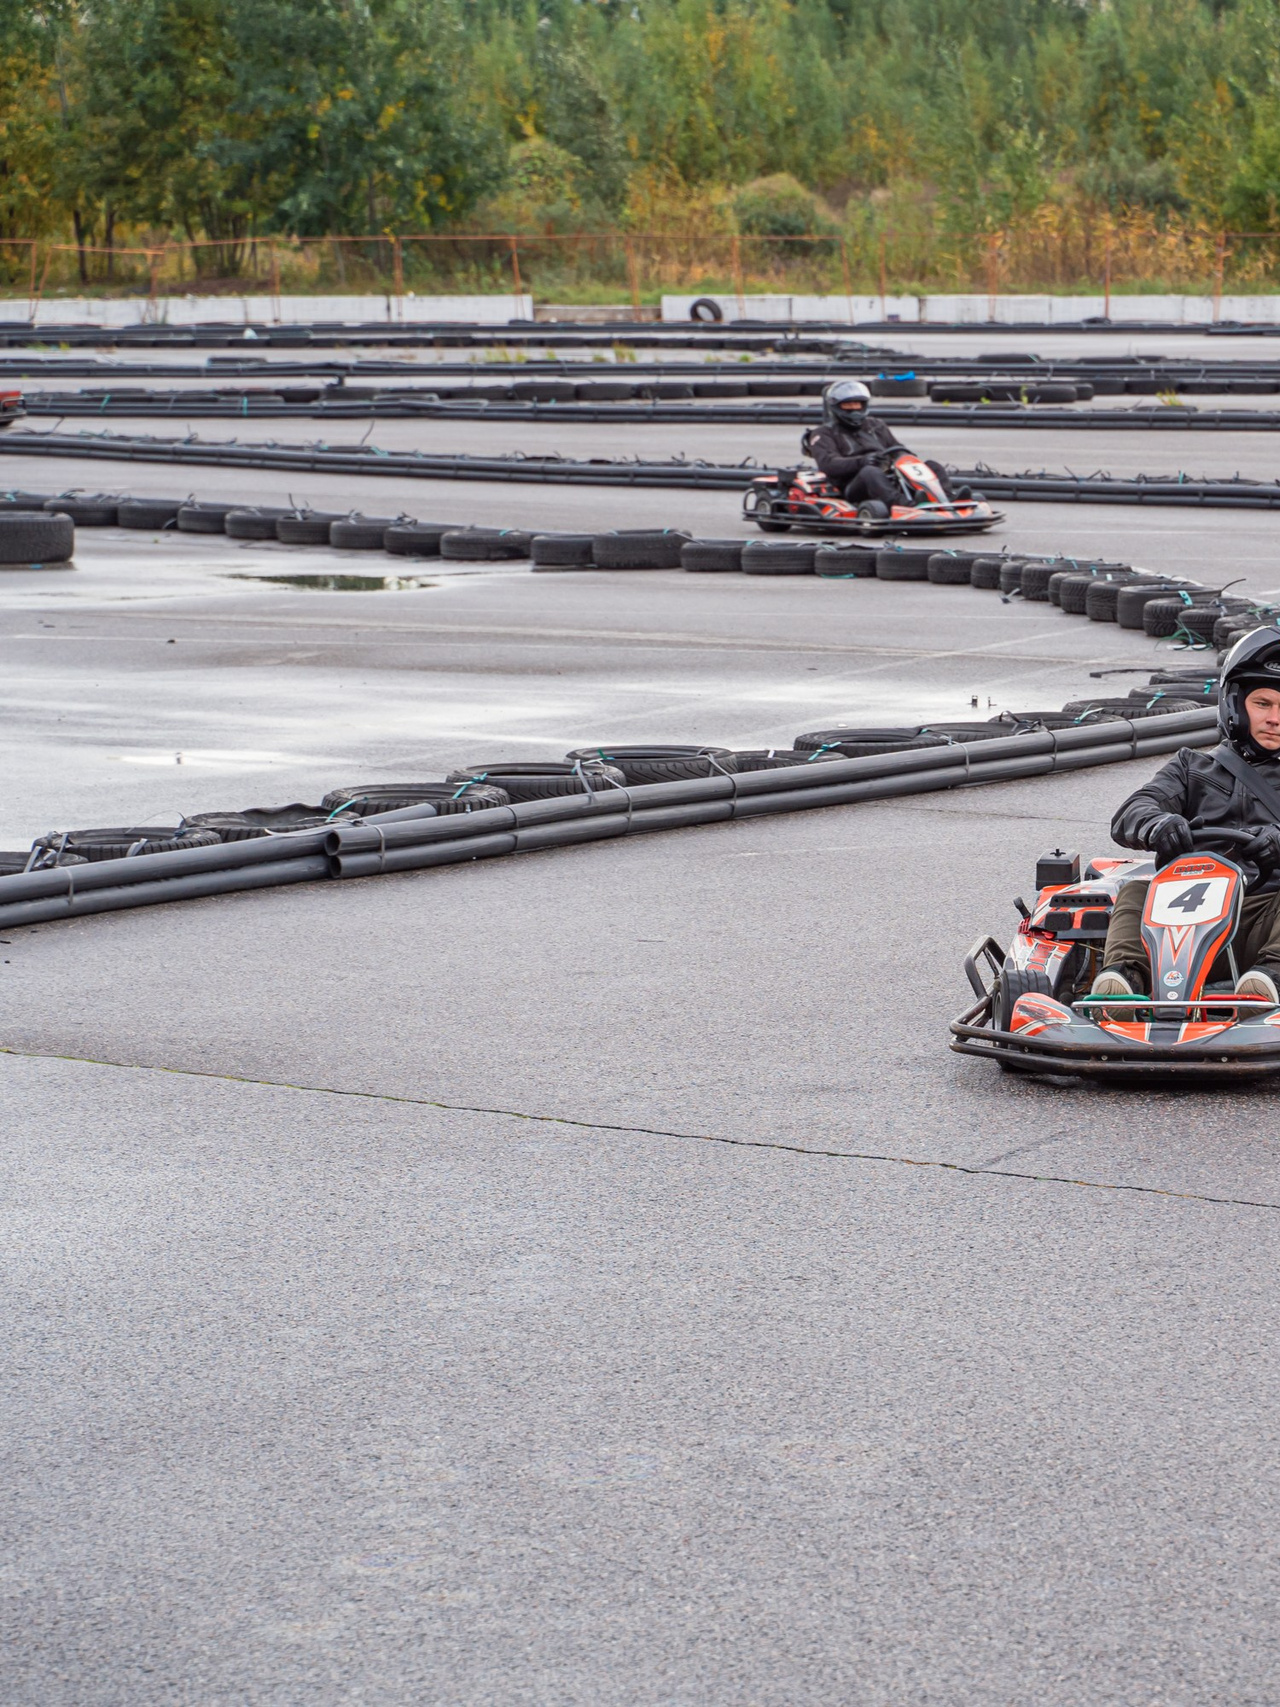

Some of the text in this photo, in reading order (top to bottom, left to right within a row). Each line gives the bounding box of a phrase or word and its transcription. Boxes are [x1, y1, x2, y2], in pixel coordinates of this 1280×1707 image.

[912, 465, 923, 476] 5
[1173, 863, 1216, 874] DINO
[1167, 882, 1212, 913] 4
